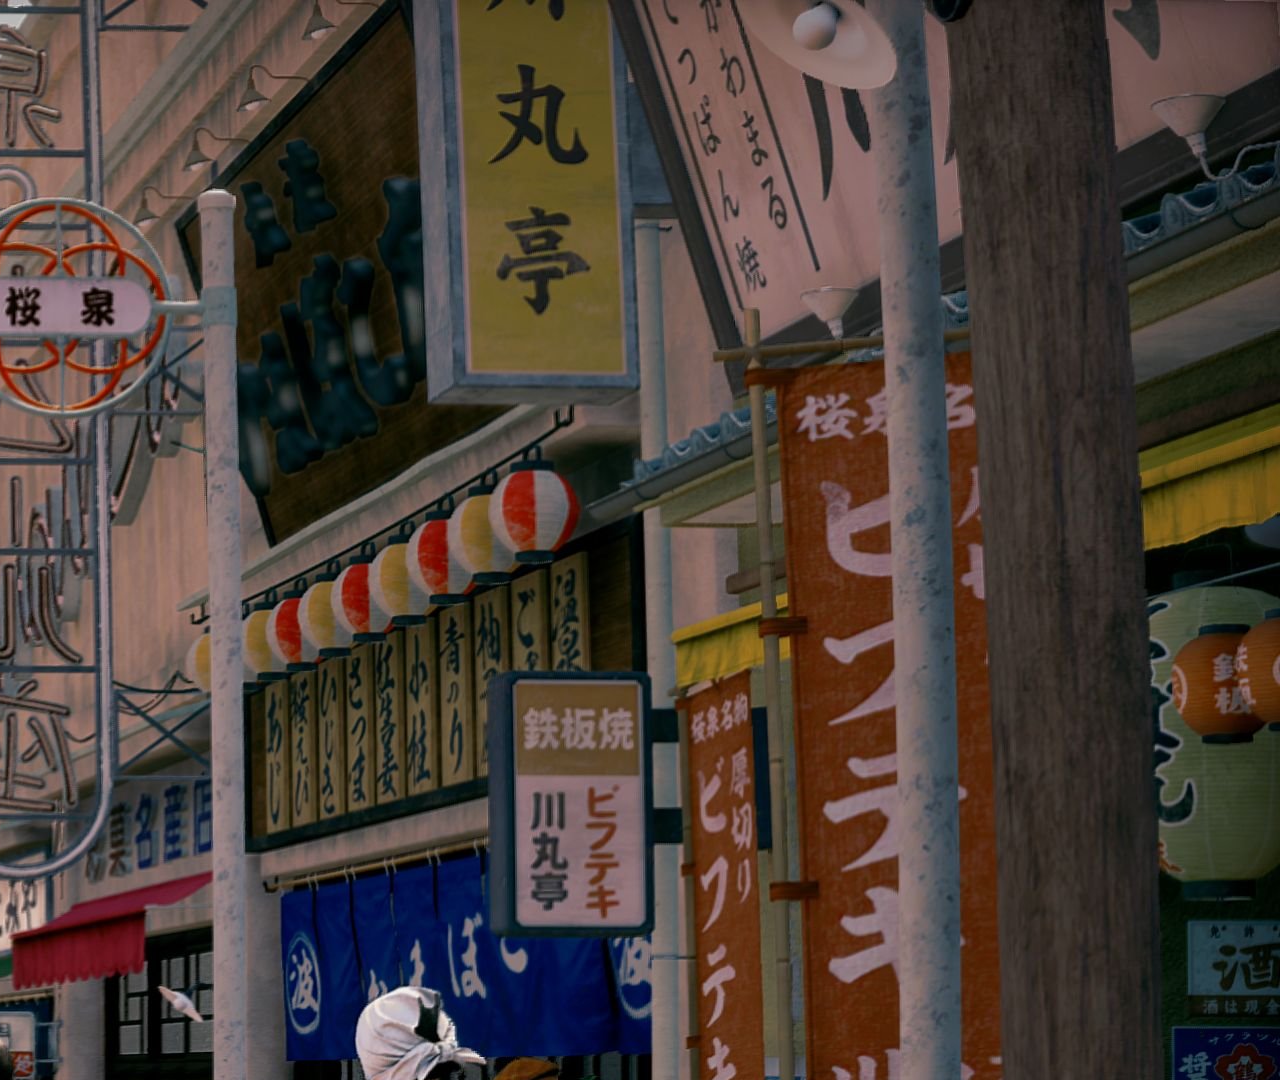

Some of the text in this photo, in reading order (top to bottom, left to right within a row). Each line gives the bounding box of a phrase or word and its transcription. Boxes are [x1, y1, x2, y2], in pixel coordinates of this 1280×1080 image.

[487, 0, 590, 315] 丸亭
[5, 287, 115, 327] 桜泉
[349, 657, 366, 803] さつま
[440, 617, 464, 774] 青のり
[522, 707, 634, 751] 鉄板焼
[531, 791, 569, 911] 川丸亭
[584, 785, 621, 918] ビフテキ
[729, 747, 756, 904] 厚切り
[1211, 943, 1280, 992] 酒
